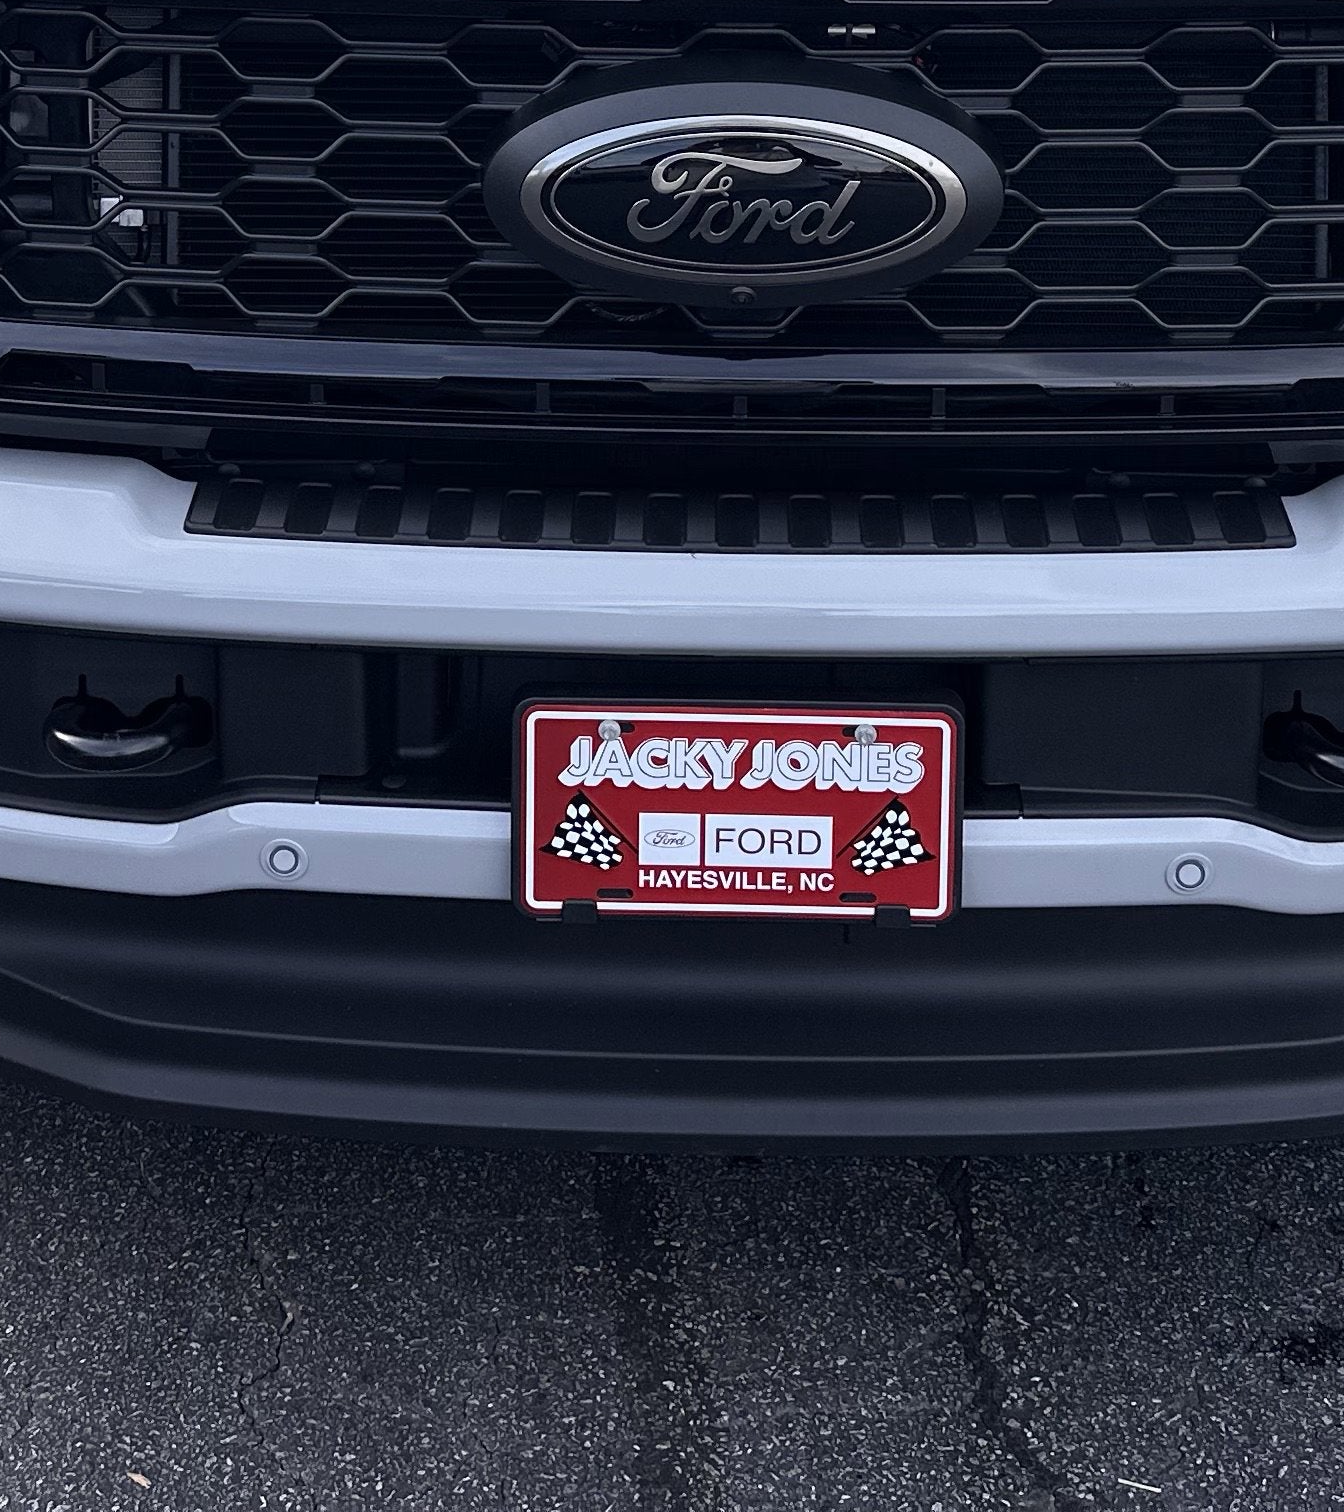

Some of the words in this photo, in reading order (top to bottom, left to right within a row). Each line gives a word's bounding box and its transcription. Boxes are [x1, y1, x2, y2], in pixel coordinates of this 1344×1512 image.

[625, 151, 862, 245] Ford
[558, 734, 749, 790] JACKY
[740, 736, 925, 794] JONES
[651, 830, 688, 848] Ford
[714, 827, 823, 857] FORD
[638, 868, 794, 893] HAYESVILLE,
[799, 872, 835, 892] NC
